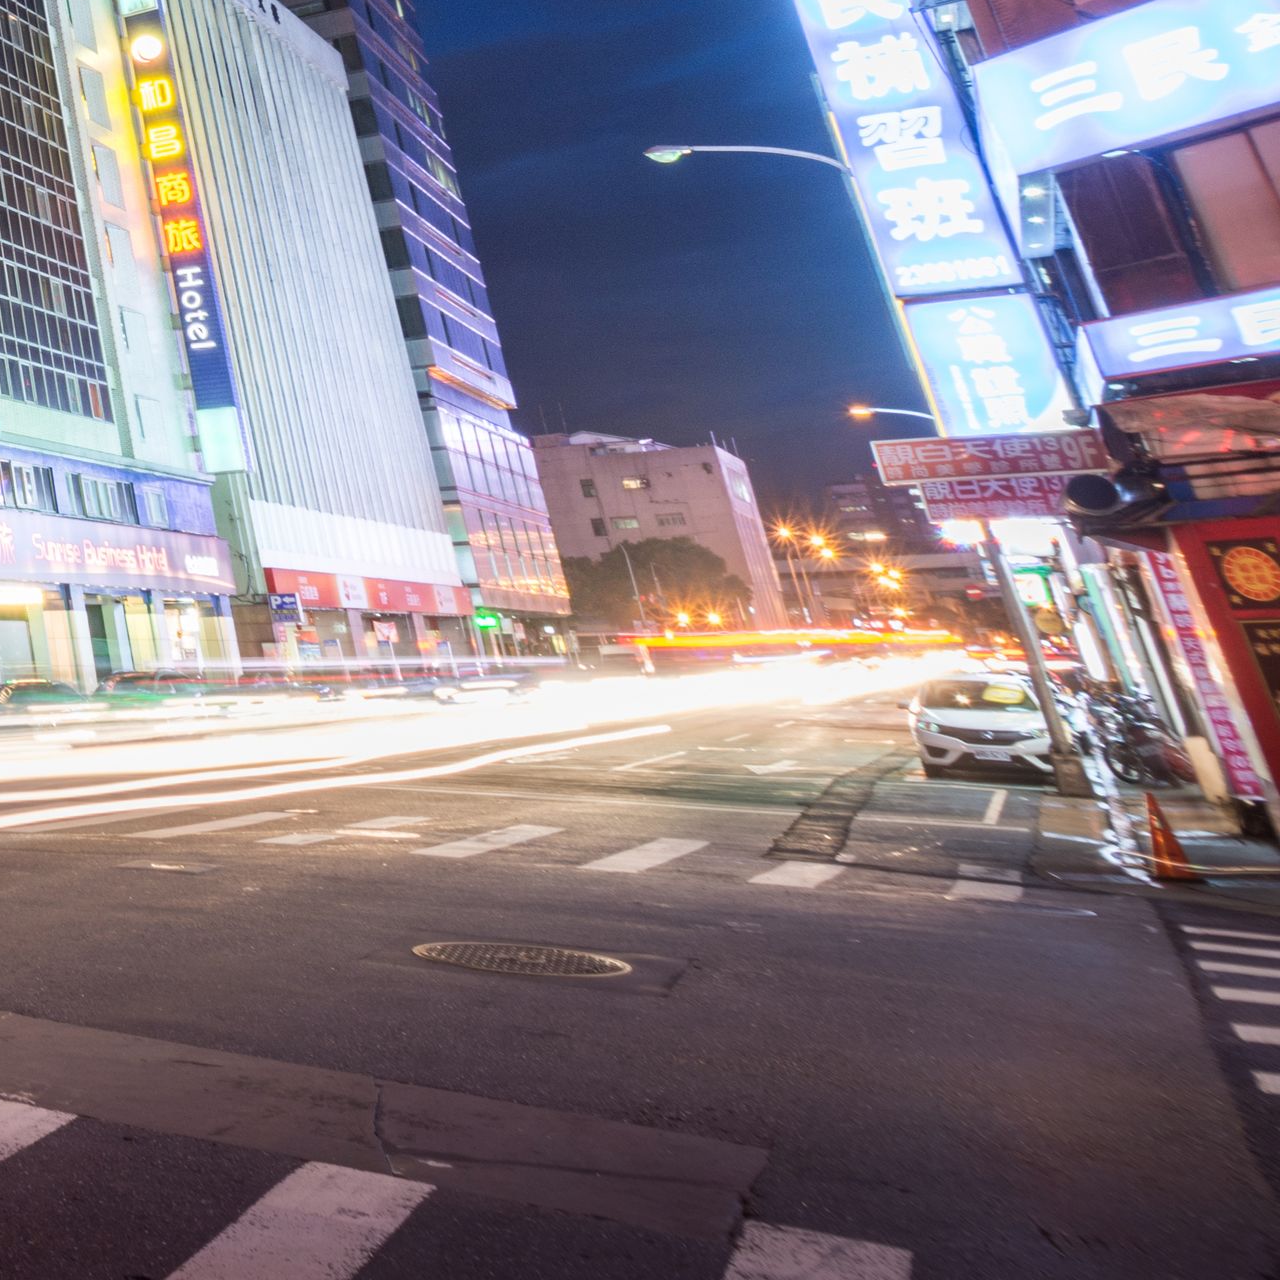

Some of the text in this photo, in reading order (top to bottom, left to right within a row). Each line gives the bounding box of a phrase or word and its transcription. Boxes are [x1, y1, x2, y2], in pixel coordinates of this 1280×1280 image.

[1030, 26, 1229, 130] 三民
[138, 77, 202, 253] 和昌商旅
[176, 266, 216, 350] Hotel
[879, 439, 1034, 466] 靚白天使
[31, 532, 81, 563] Sunrise
[83, 538, 137, 568] Business
[137, 542, 169, 570] Hotel
